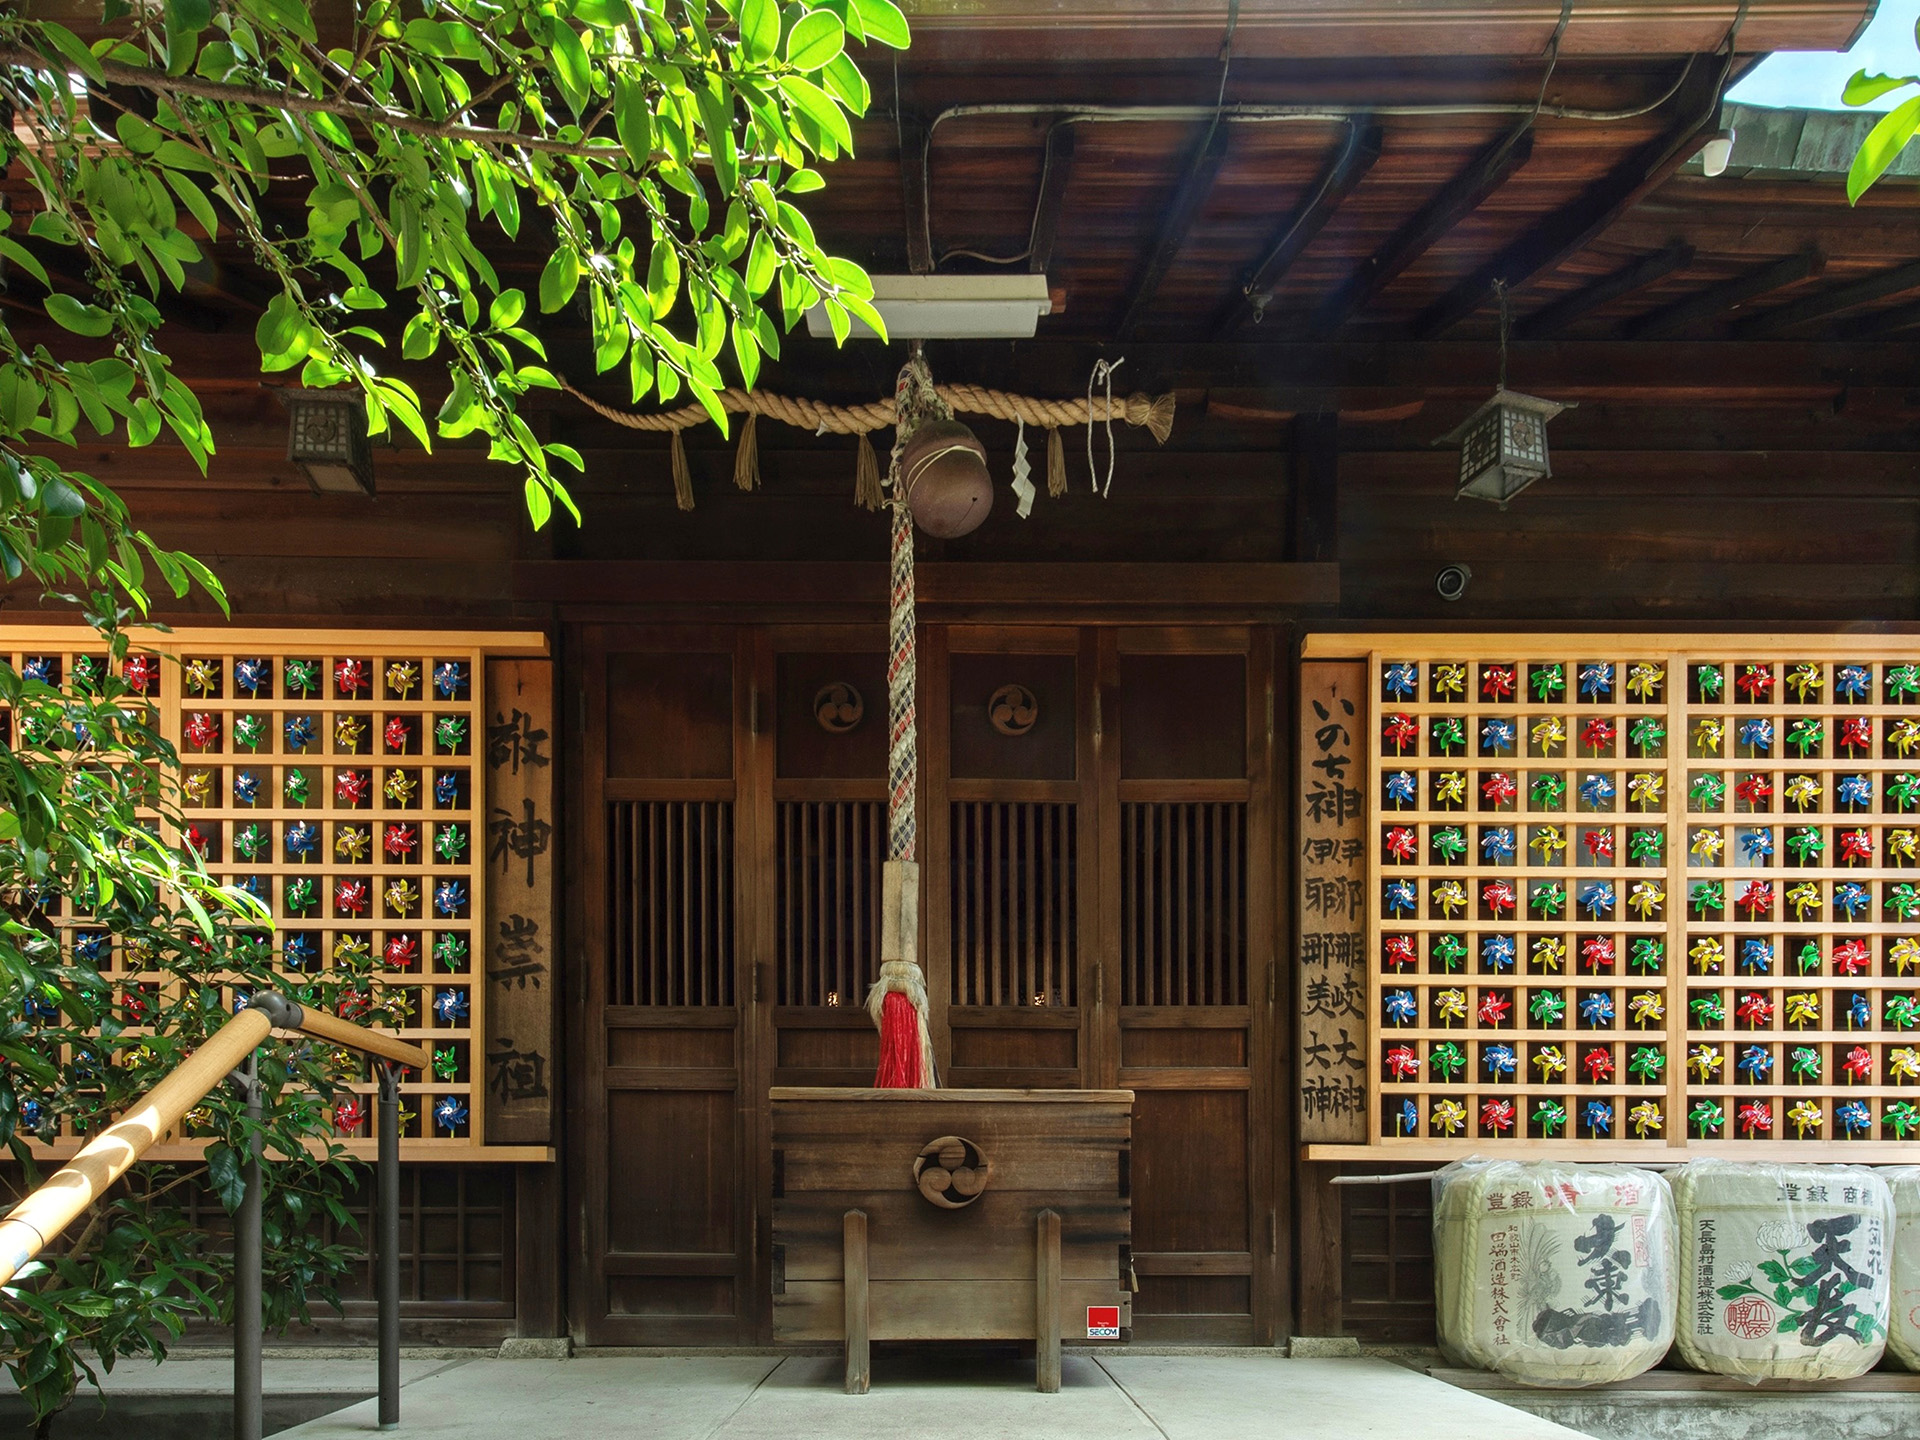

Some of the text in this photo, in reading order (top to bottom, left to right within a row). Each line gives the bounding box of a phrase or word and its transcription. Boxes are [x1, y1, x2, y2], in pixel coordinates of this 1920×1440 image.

[486, 707, 551, 1105] 敬神崇祖
[1089, 1328, 1117, 1336] SECOM
[1697, 1219, 1716, 1336] 天長島村酒造株式会社
